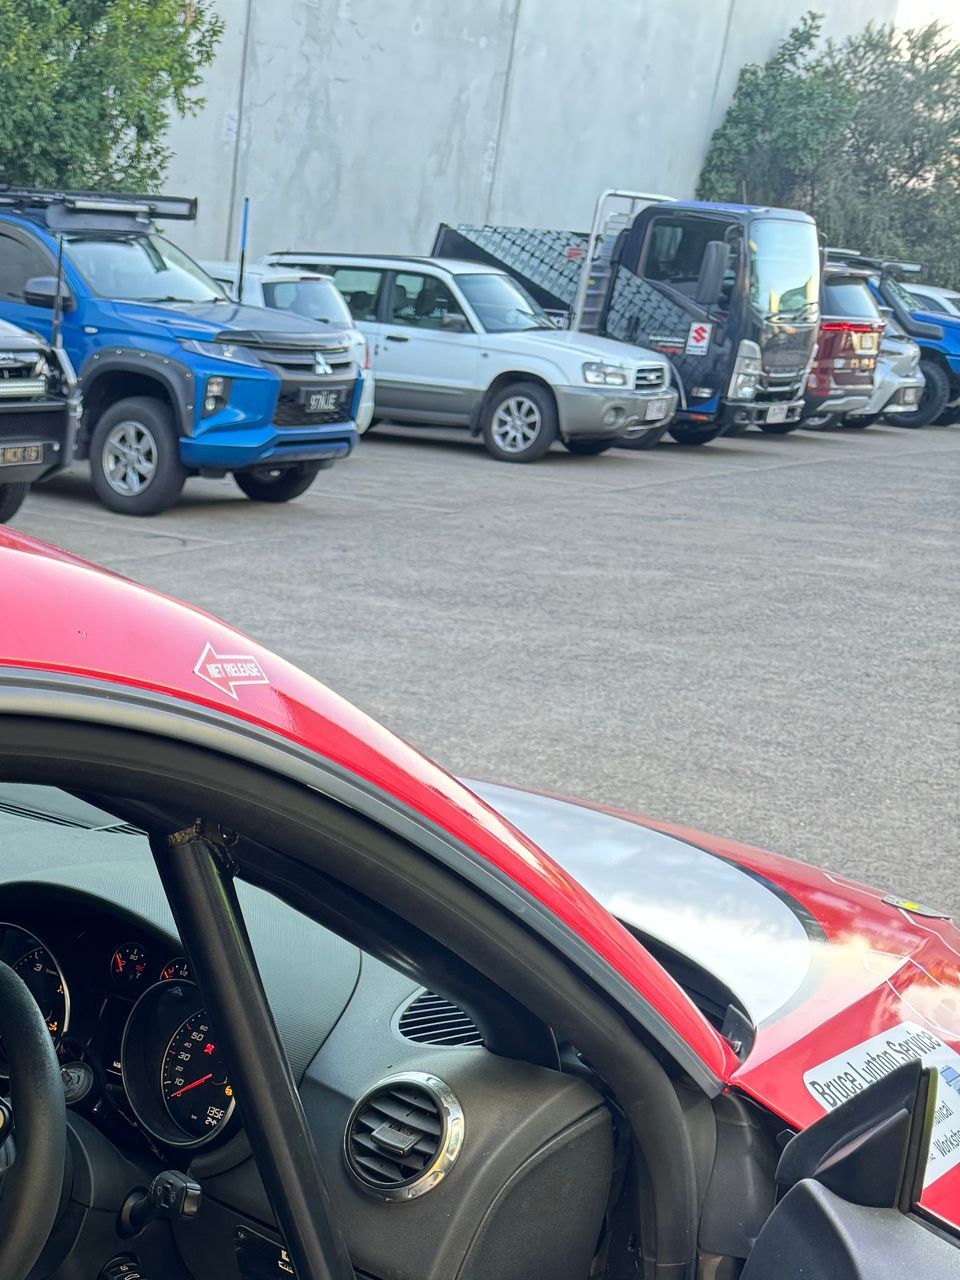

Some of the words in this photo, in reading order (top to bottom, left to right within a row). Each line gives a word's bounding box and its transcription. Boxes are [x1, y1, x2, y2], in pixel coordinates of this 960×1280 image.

[33, 963, 42, 972] 3
[190, 1032, 204, 1042] 50
[178, 1051, 191, 1061] 30
[809, 1070, 864, 1108] Bruce
[885, 1030, 942, 1067] Service
[174, 1077, 184, 1086] 10
